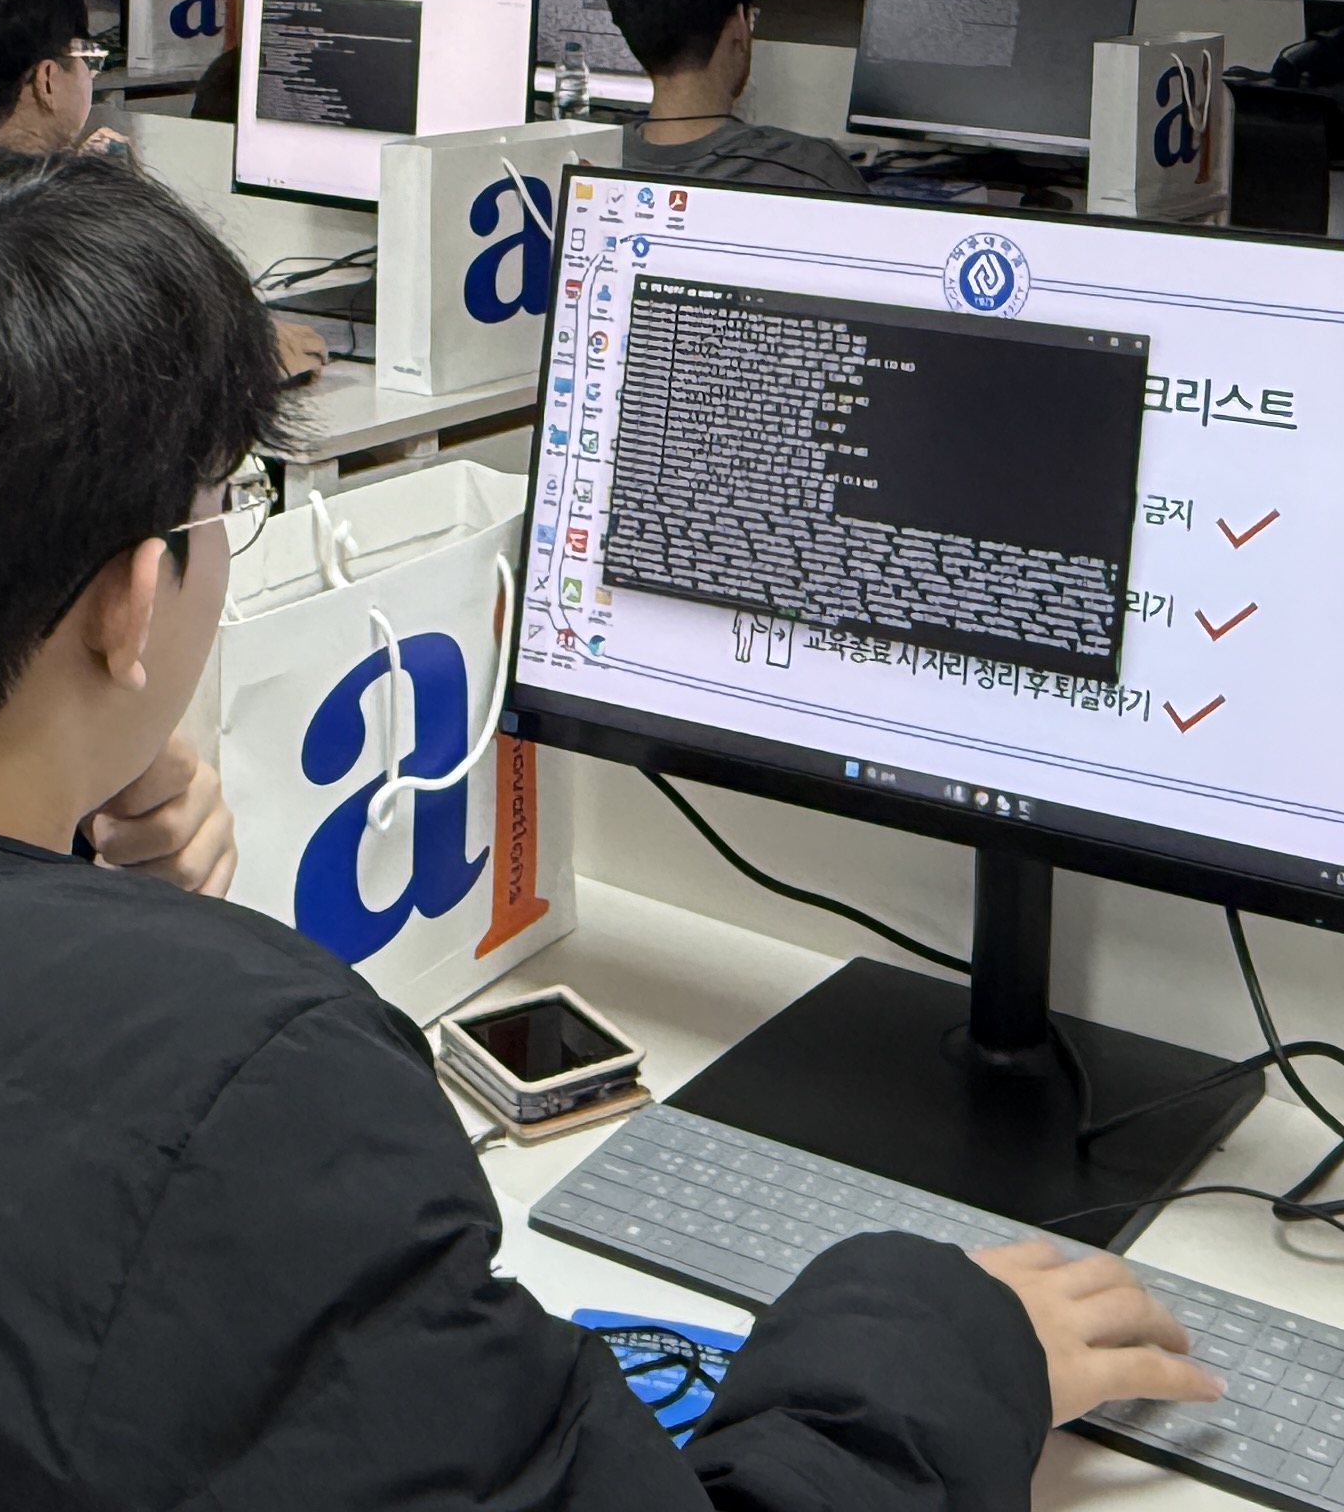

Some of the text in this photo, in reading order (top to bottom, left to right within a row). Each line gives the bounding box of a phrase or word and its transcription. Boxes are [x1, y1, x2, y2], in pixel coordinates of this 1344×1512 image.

[1142, 493, 1195, 532] 금지
[896, 644, 918, 677] 시
[922, 648, 969, 686] 자리
[974, 659, 1020, 696] 정리
[1023, 669, 1050, 700] 후
[1052, 678, 1151, 722] 퇴실하기
